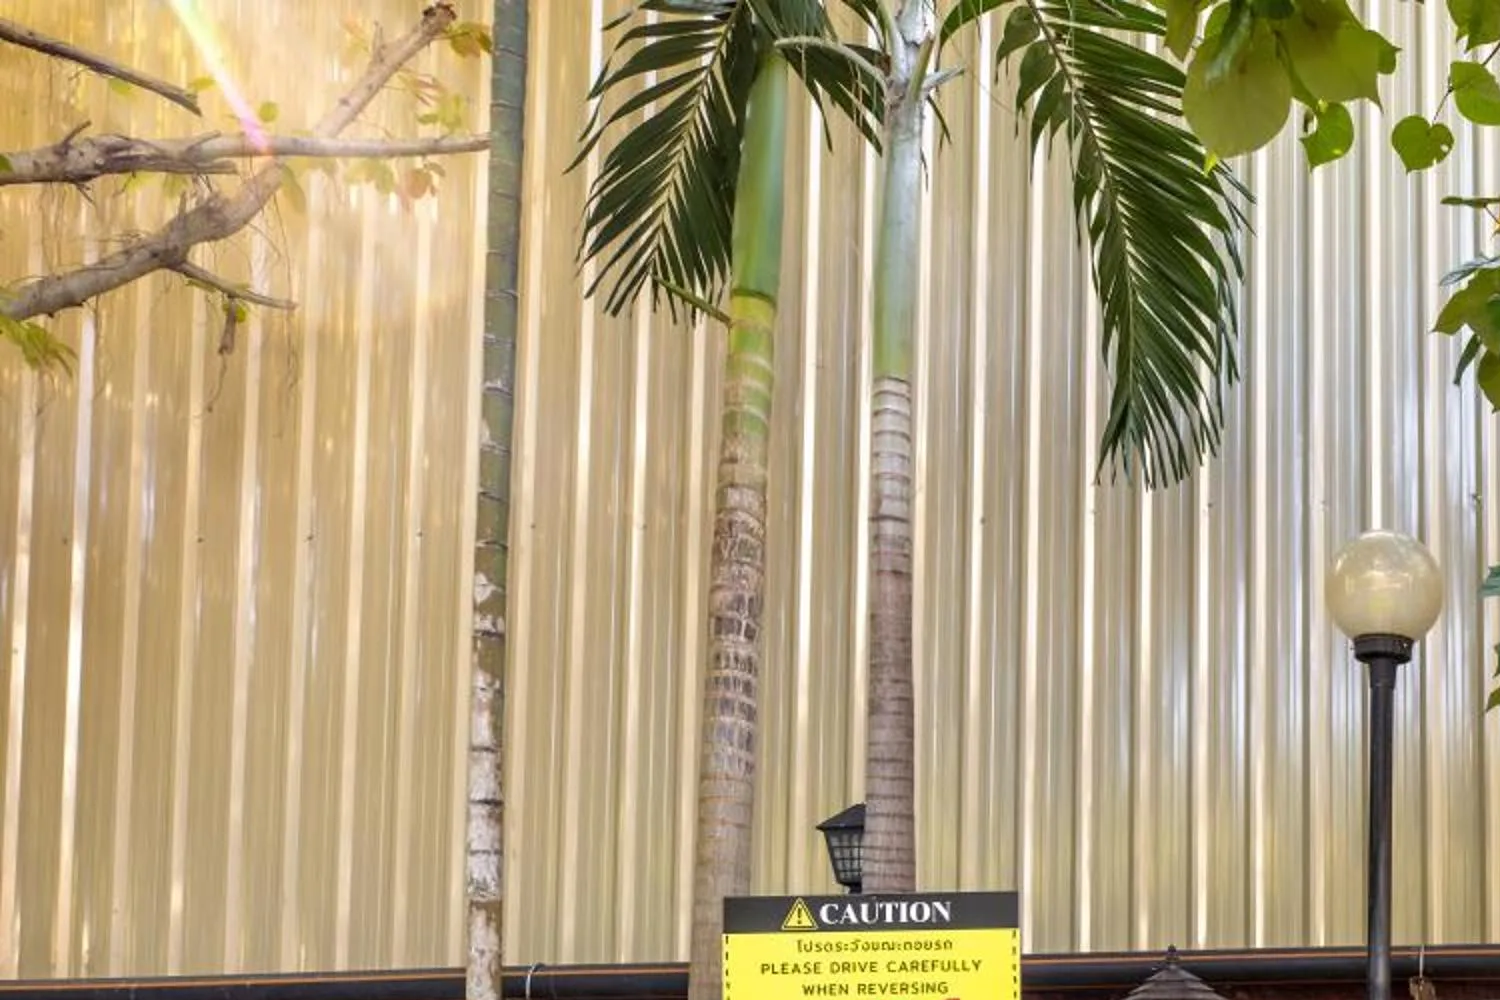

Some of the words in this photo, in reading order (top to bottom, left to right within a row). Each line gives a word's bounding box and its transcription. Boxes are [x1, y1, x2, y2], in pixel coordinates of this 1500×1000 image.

[819, 901, 952, 925] CAUTION
[760, 962, 822, 975] PLEASE
[829, 961, 878, 974] DRIVE
[886, 959, 983, 973] CAREFULLY
[802, 983, 849, 996] WHEN
[857, 982, 949, 995] REVERSING
